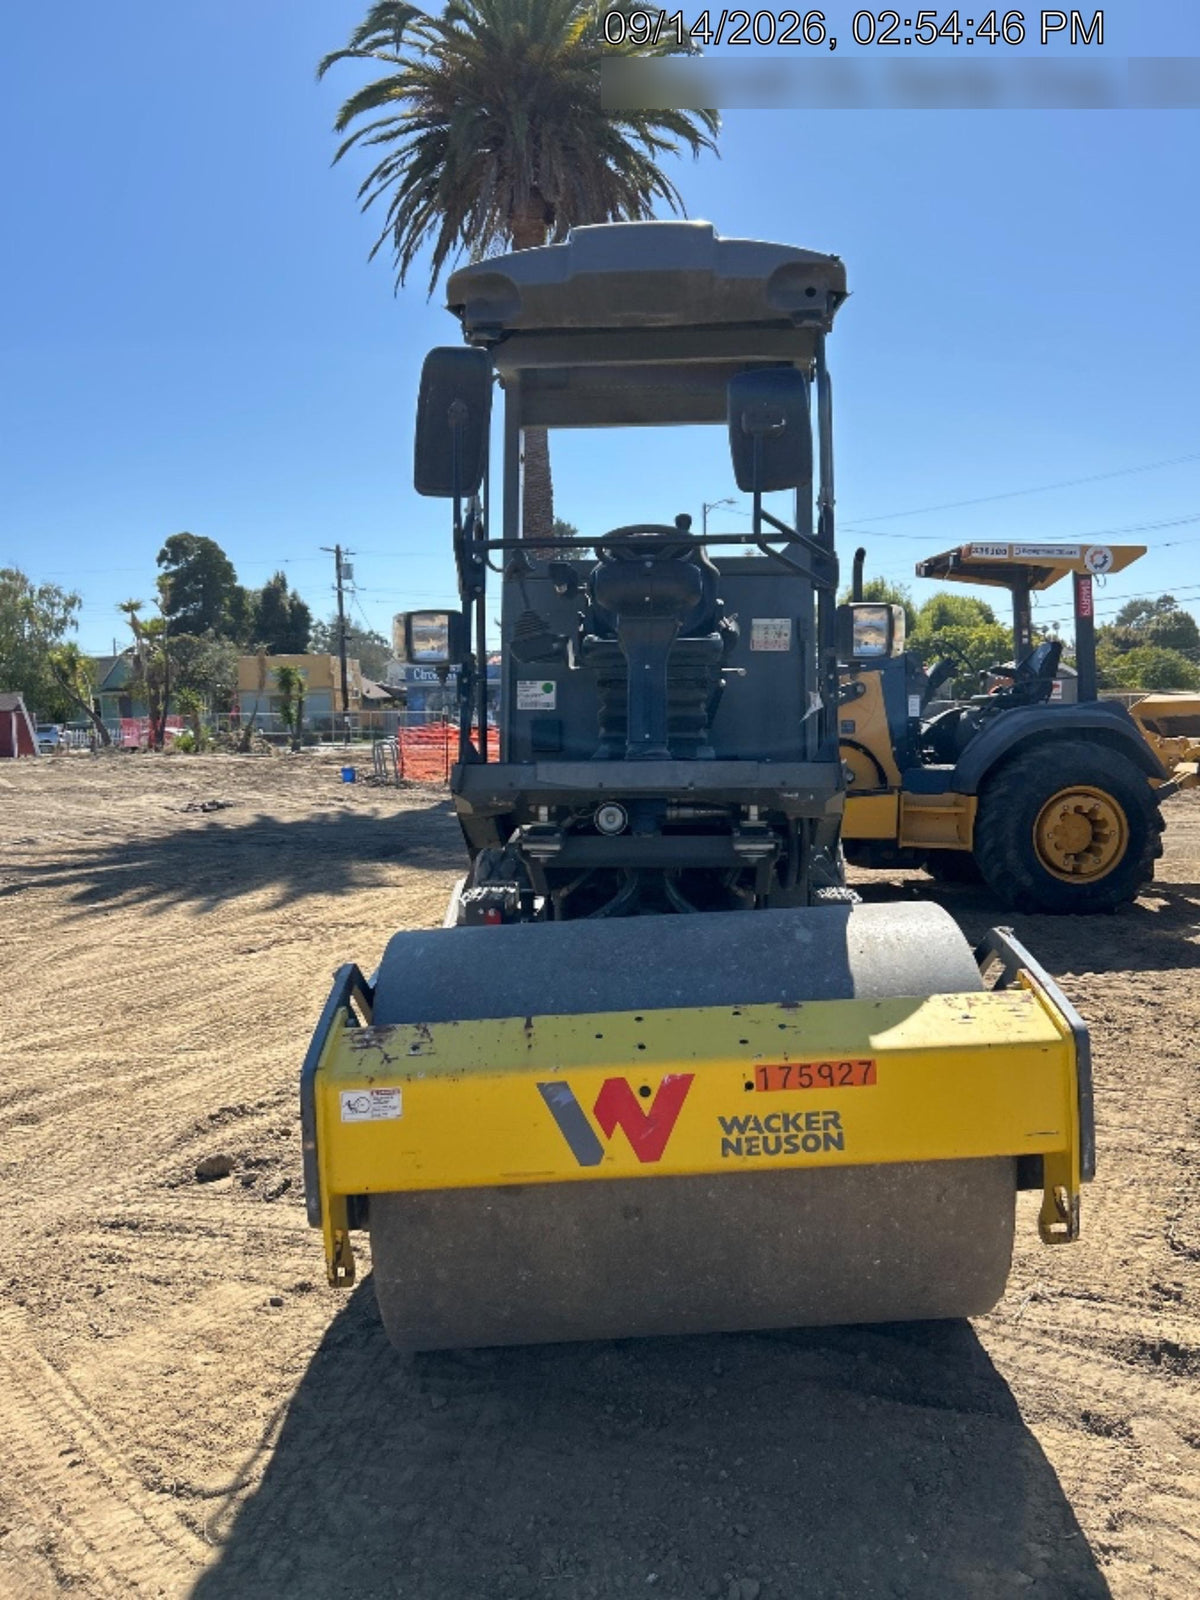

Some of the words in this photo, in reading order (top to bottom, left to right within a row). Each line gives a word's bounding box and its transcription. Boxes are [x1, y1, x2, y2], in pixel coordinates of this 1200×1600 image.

[758, 1060, 873, 1091] 175927
[718, 1110, 843, 1136] WACKER
[721, 1131, 845, 1158] NEUSON
